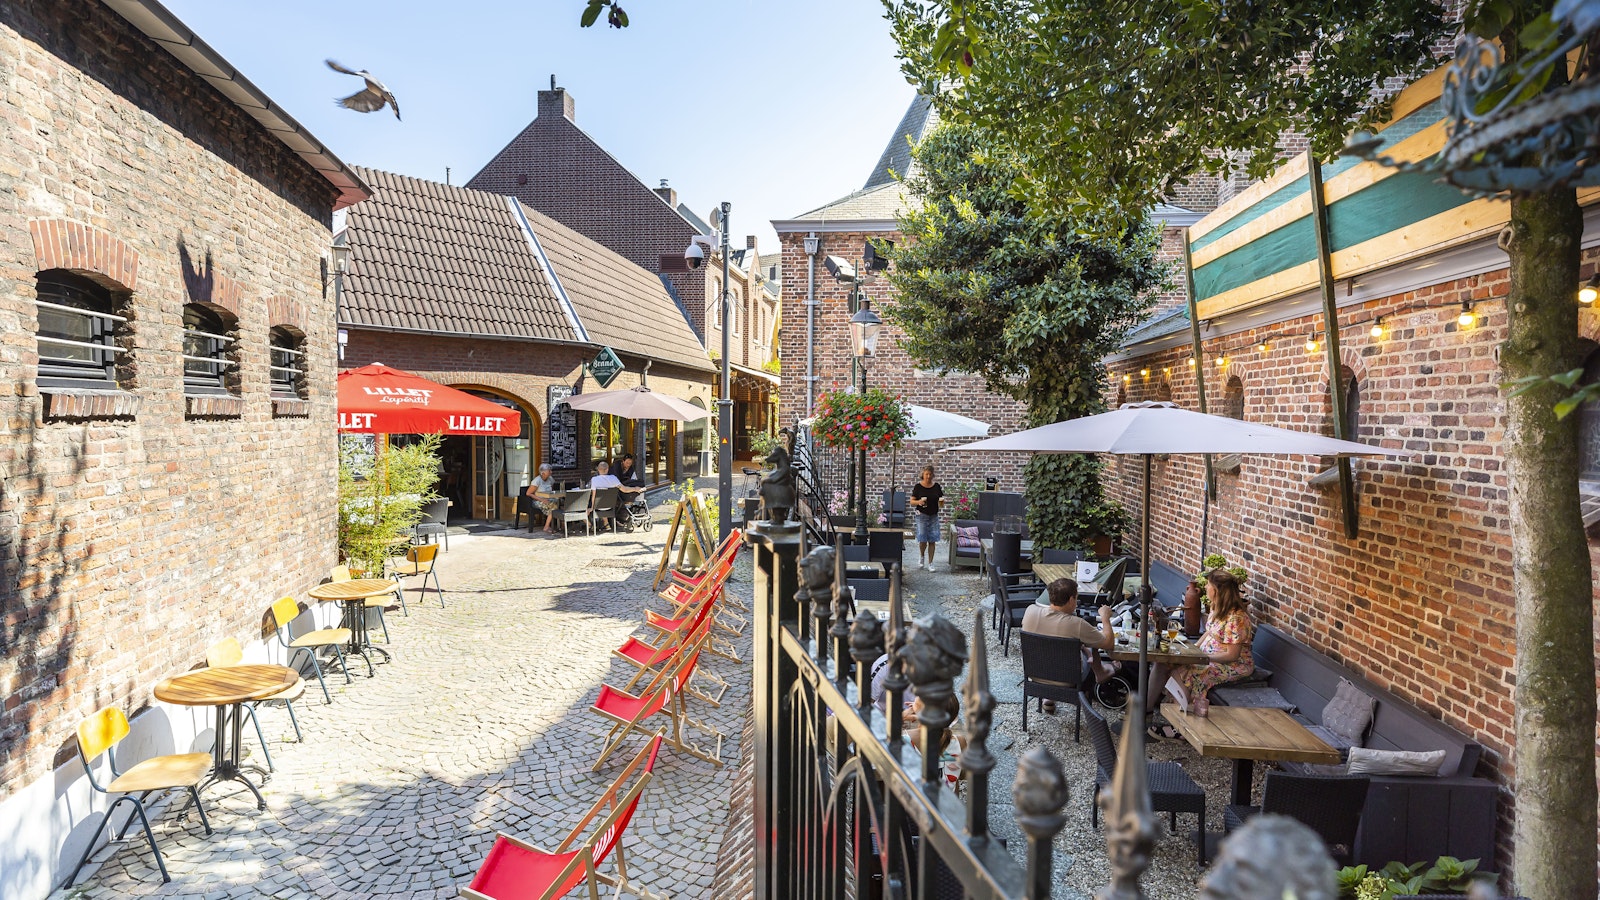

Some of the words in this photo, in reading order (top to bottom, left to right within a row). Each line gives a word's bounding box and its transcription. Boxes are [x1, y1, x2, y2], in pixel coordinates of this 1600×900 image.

[593, 359, 614, 368] Brand
[363, 387, 433, 398] LILLET
[338, 413, 376, 429] LET
[449, 415, 505, 431] LILLET
